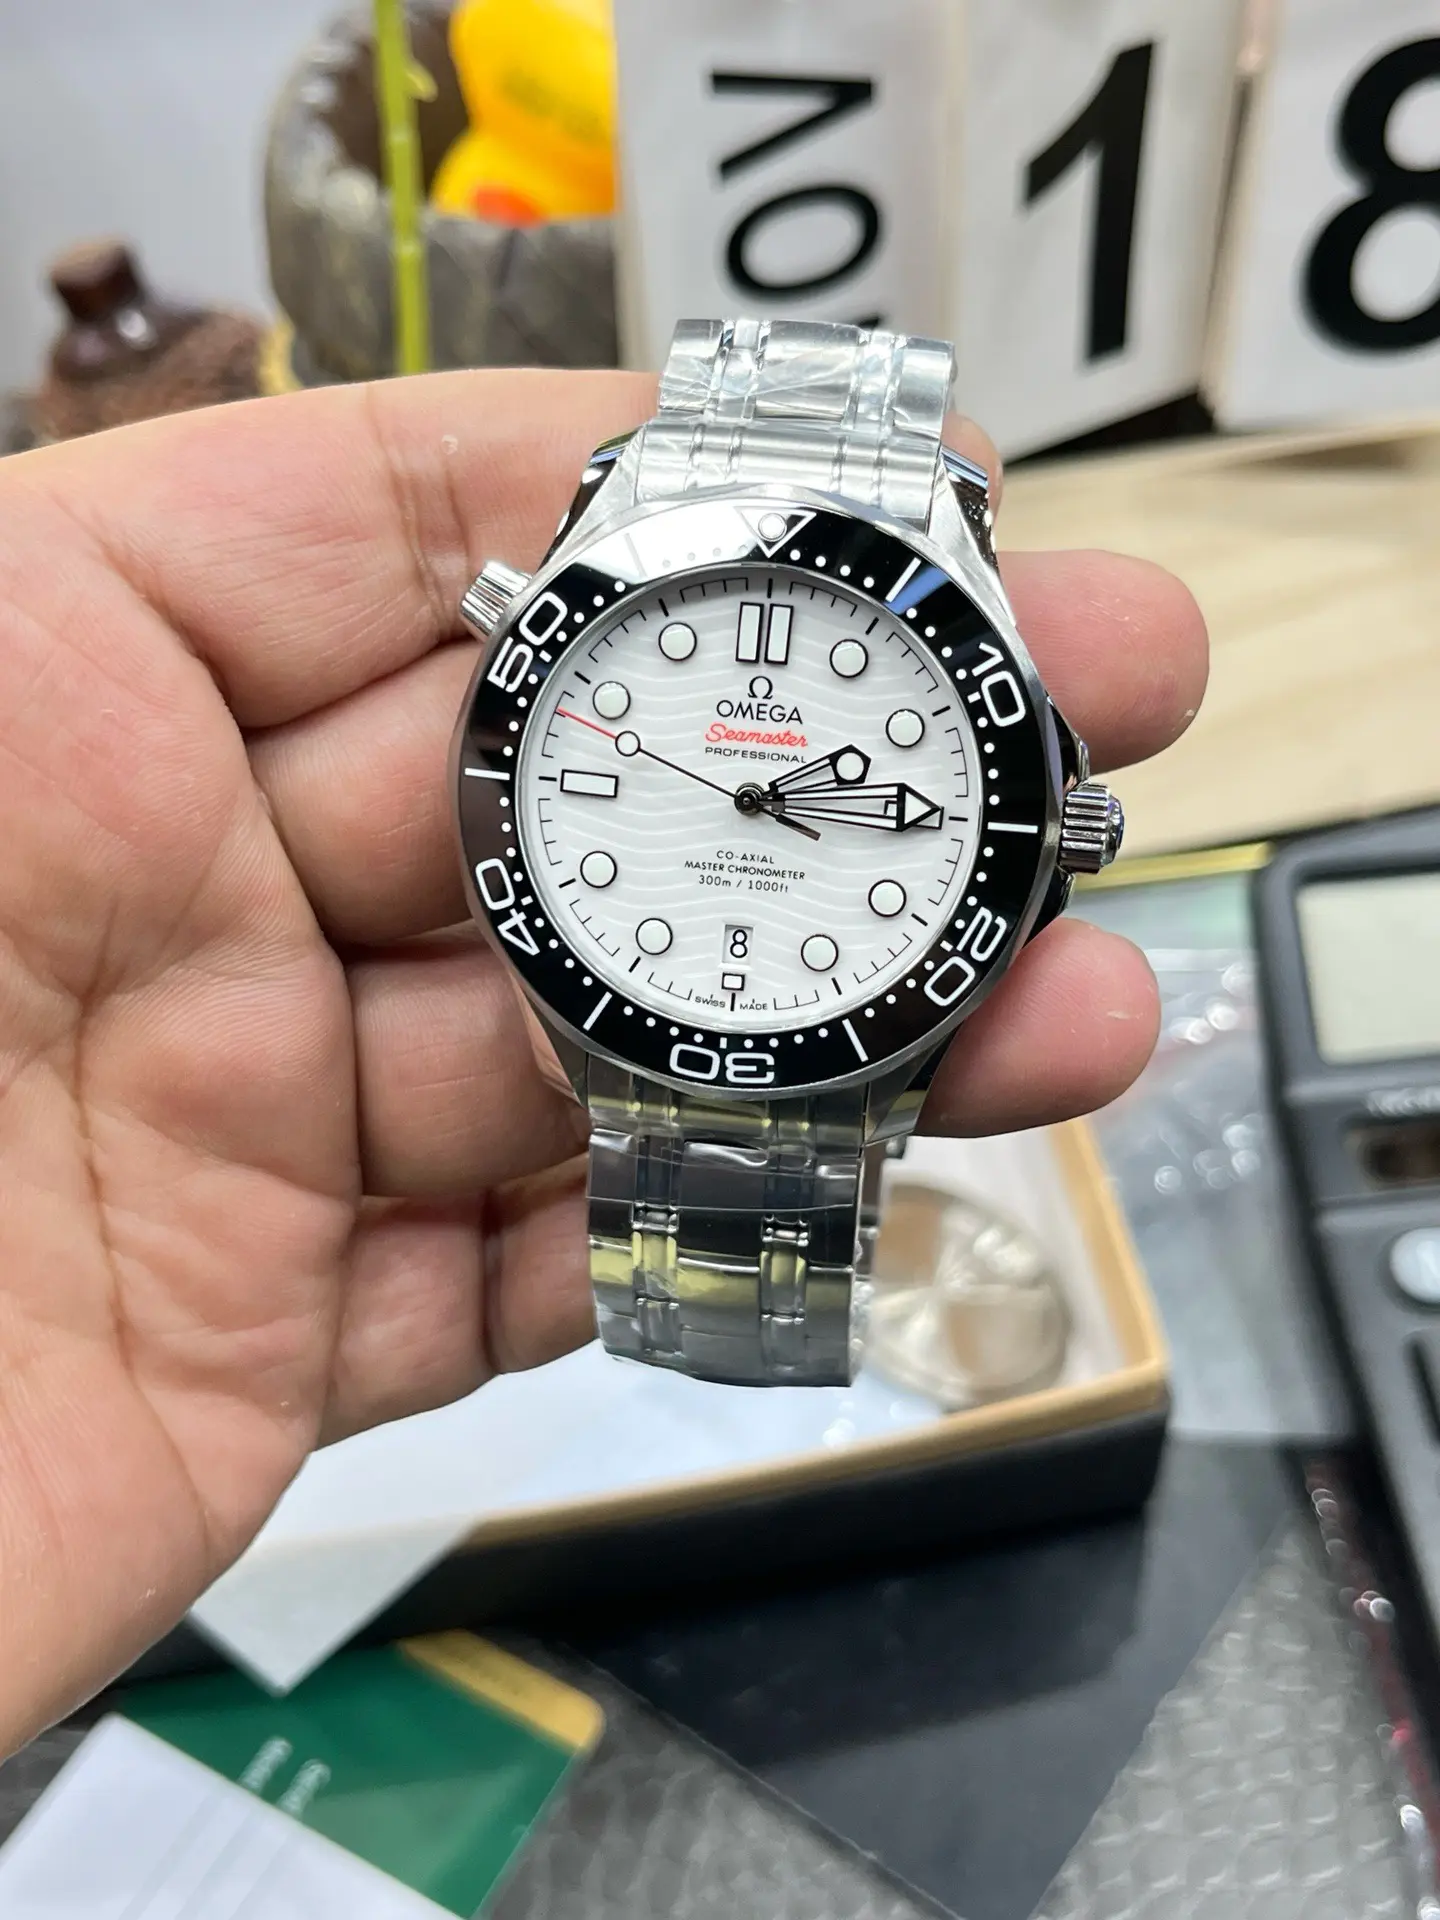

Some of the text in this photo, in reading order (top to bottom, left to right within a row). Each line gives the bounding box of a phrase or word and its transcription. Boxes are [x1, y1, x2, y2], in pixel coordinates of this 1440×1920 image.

[708, 68, 882, 328] OV
[487, 591, 567, 692] 50
[971, 642, 1025, 726] 10
[716, 700, 803, 725] OMEGA
[705, 722, 808, 747] Seamaster
[705, 746, 807, 764] PROFESSIONAL
[684, 860, 806, 881] MASTER CHRONOMETER
[716, 850, 775, 865] CO-AXIAL
[698, 874, 732, 888] 300m
[747, 880, 789, 893] 1000ft
[474, 858, 541, 956] 40
[729, 929, 748, 959] 8
[924, 906, 1007, 1007] 20
[694, 995, 768, 1011] SWISS MADE
[669, 1043, 775, 1085] 30
